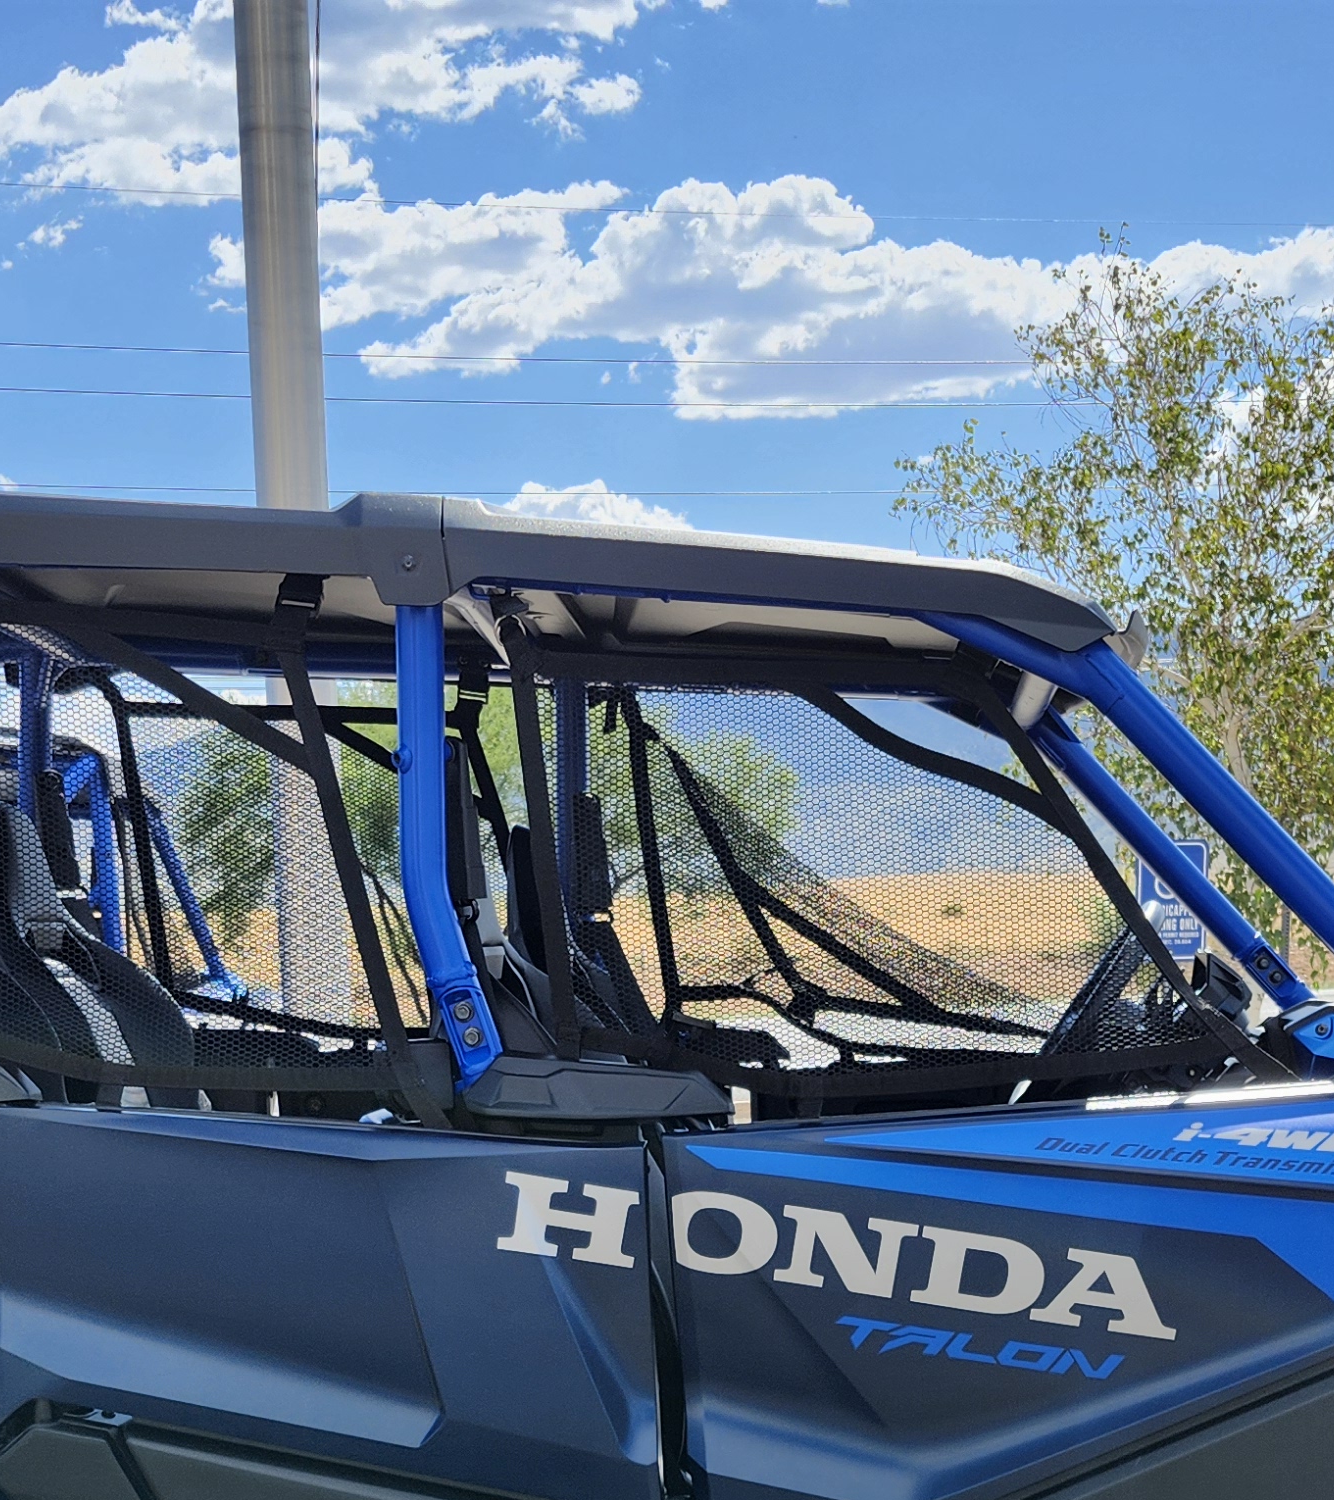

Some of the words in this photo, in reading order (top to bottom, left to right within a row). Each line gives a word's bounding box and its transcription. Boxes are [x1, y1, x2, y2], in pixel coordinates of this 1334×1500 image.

[1035, 1137, 1110, 1156] Dual
[1110, 1143, 1210, 1165] Clutch
[496, 1171, 1177, 1341] HONDA
[835, 1315, 1126, 1380] TALON
